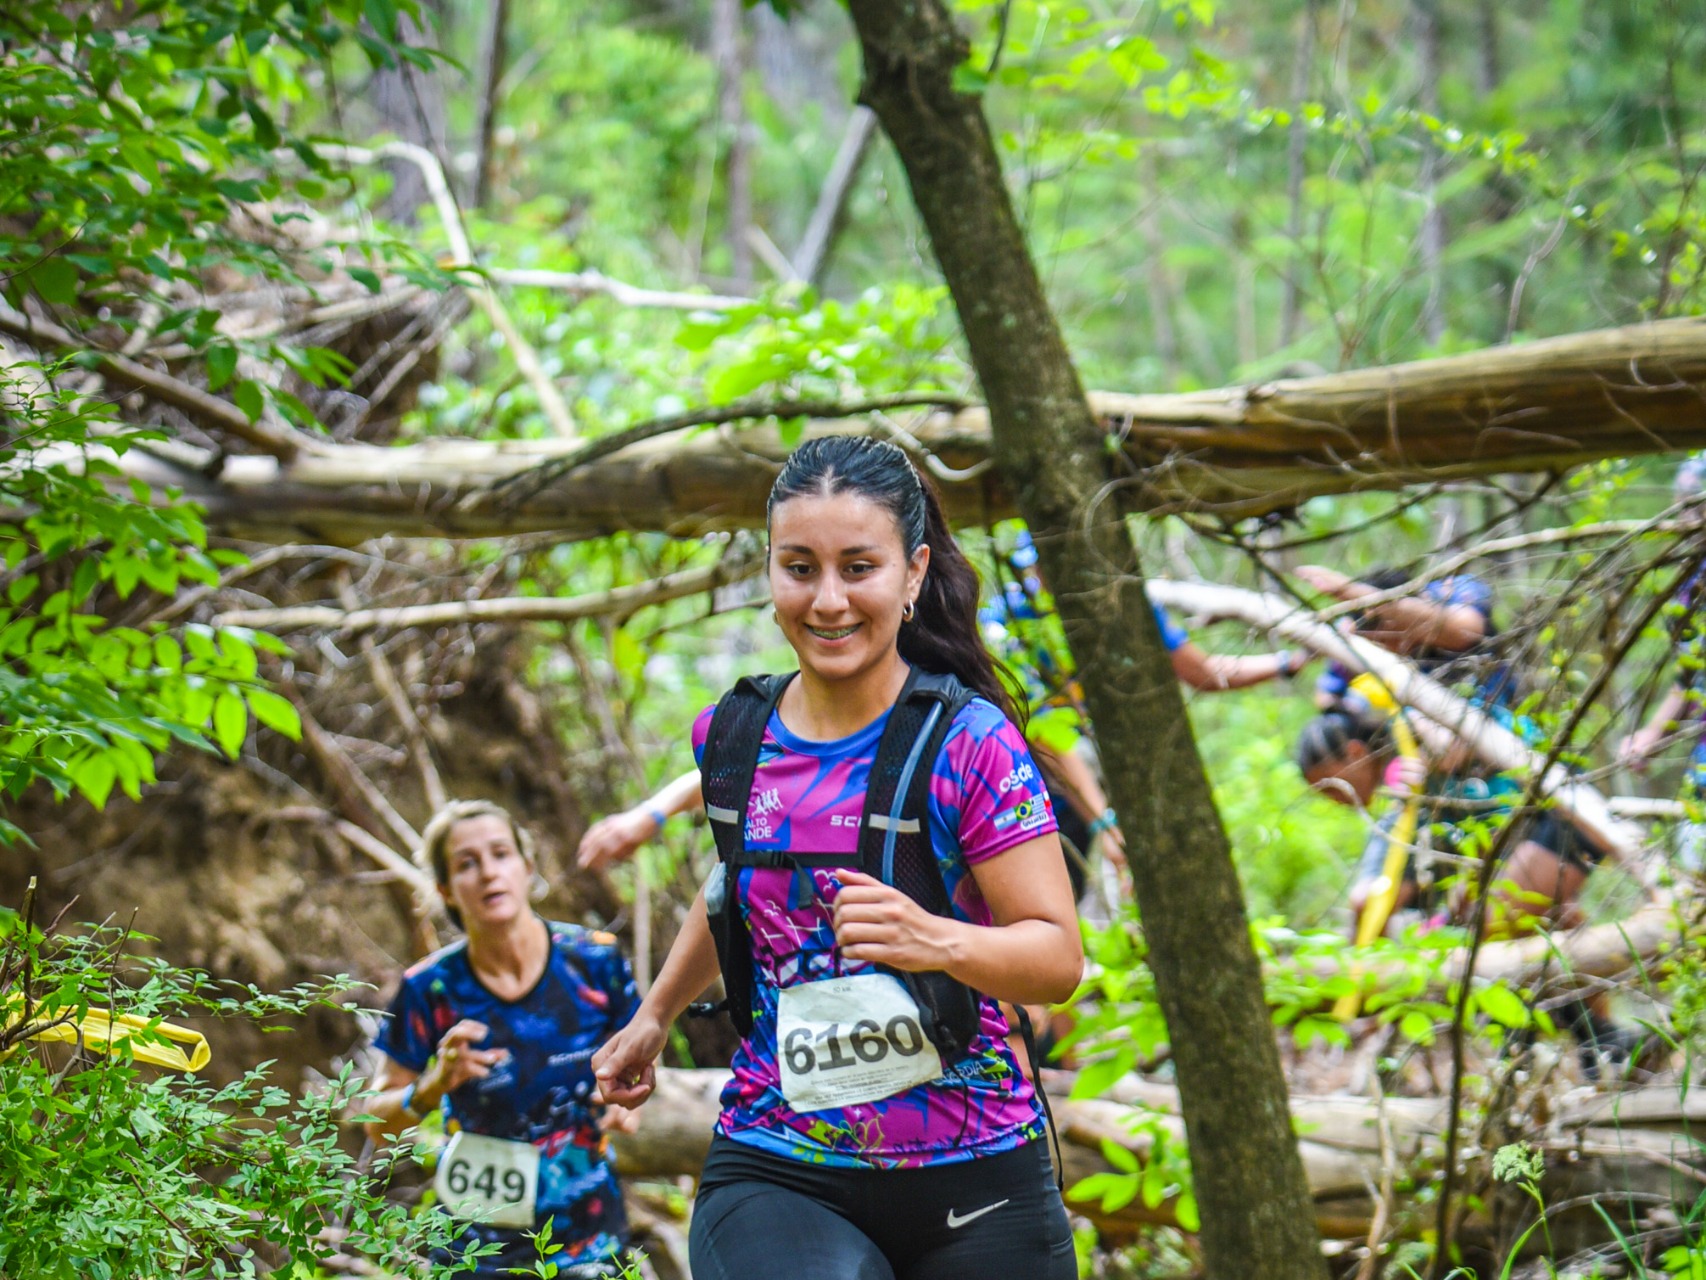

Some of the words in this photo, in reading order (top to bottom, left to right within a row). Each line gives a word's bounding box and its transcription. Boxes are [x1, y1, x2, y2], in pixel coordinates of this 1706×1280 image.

[999, 761, 1034, 793] osde
[745, 817, 768, 829] ALTO
[784, 1015, 924, 1075] 6160
[447, 1157, 526, 1204] 649
